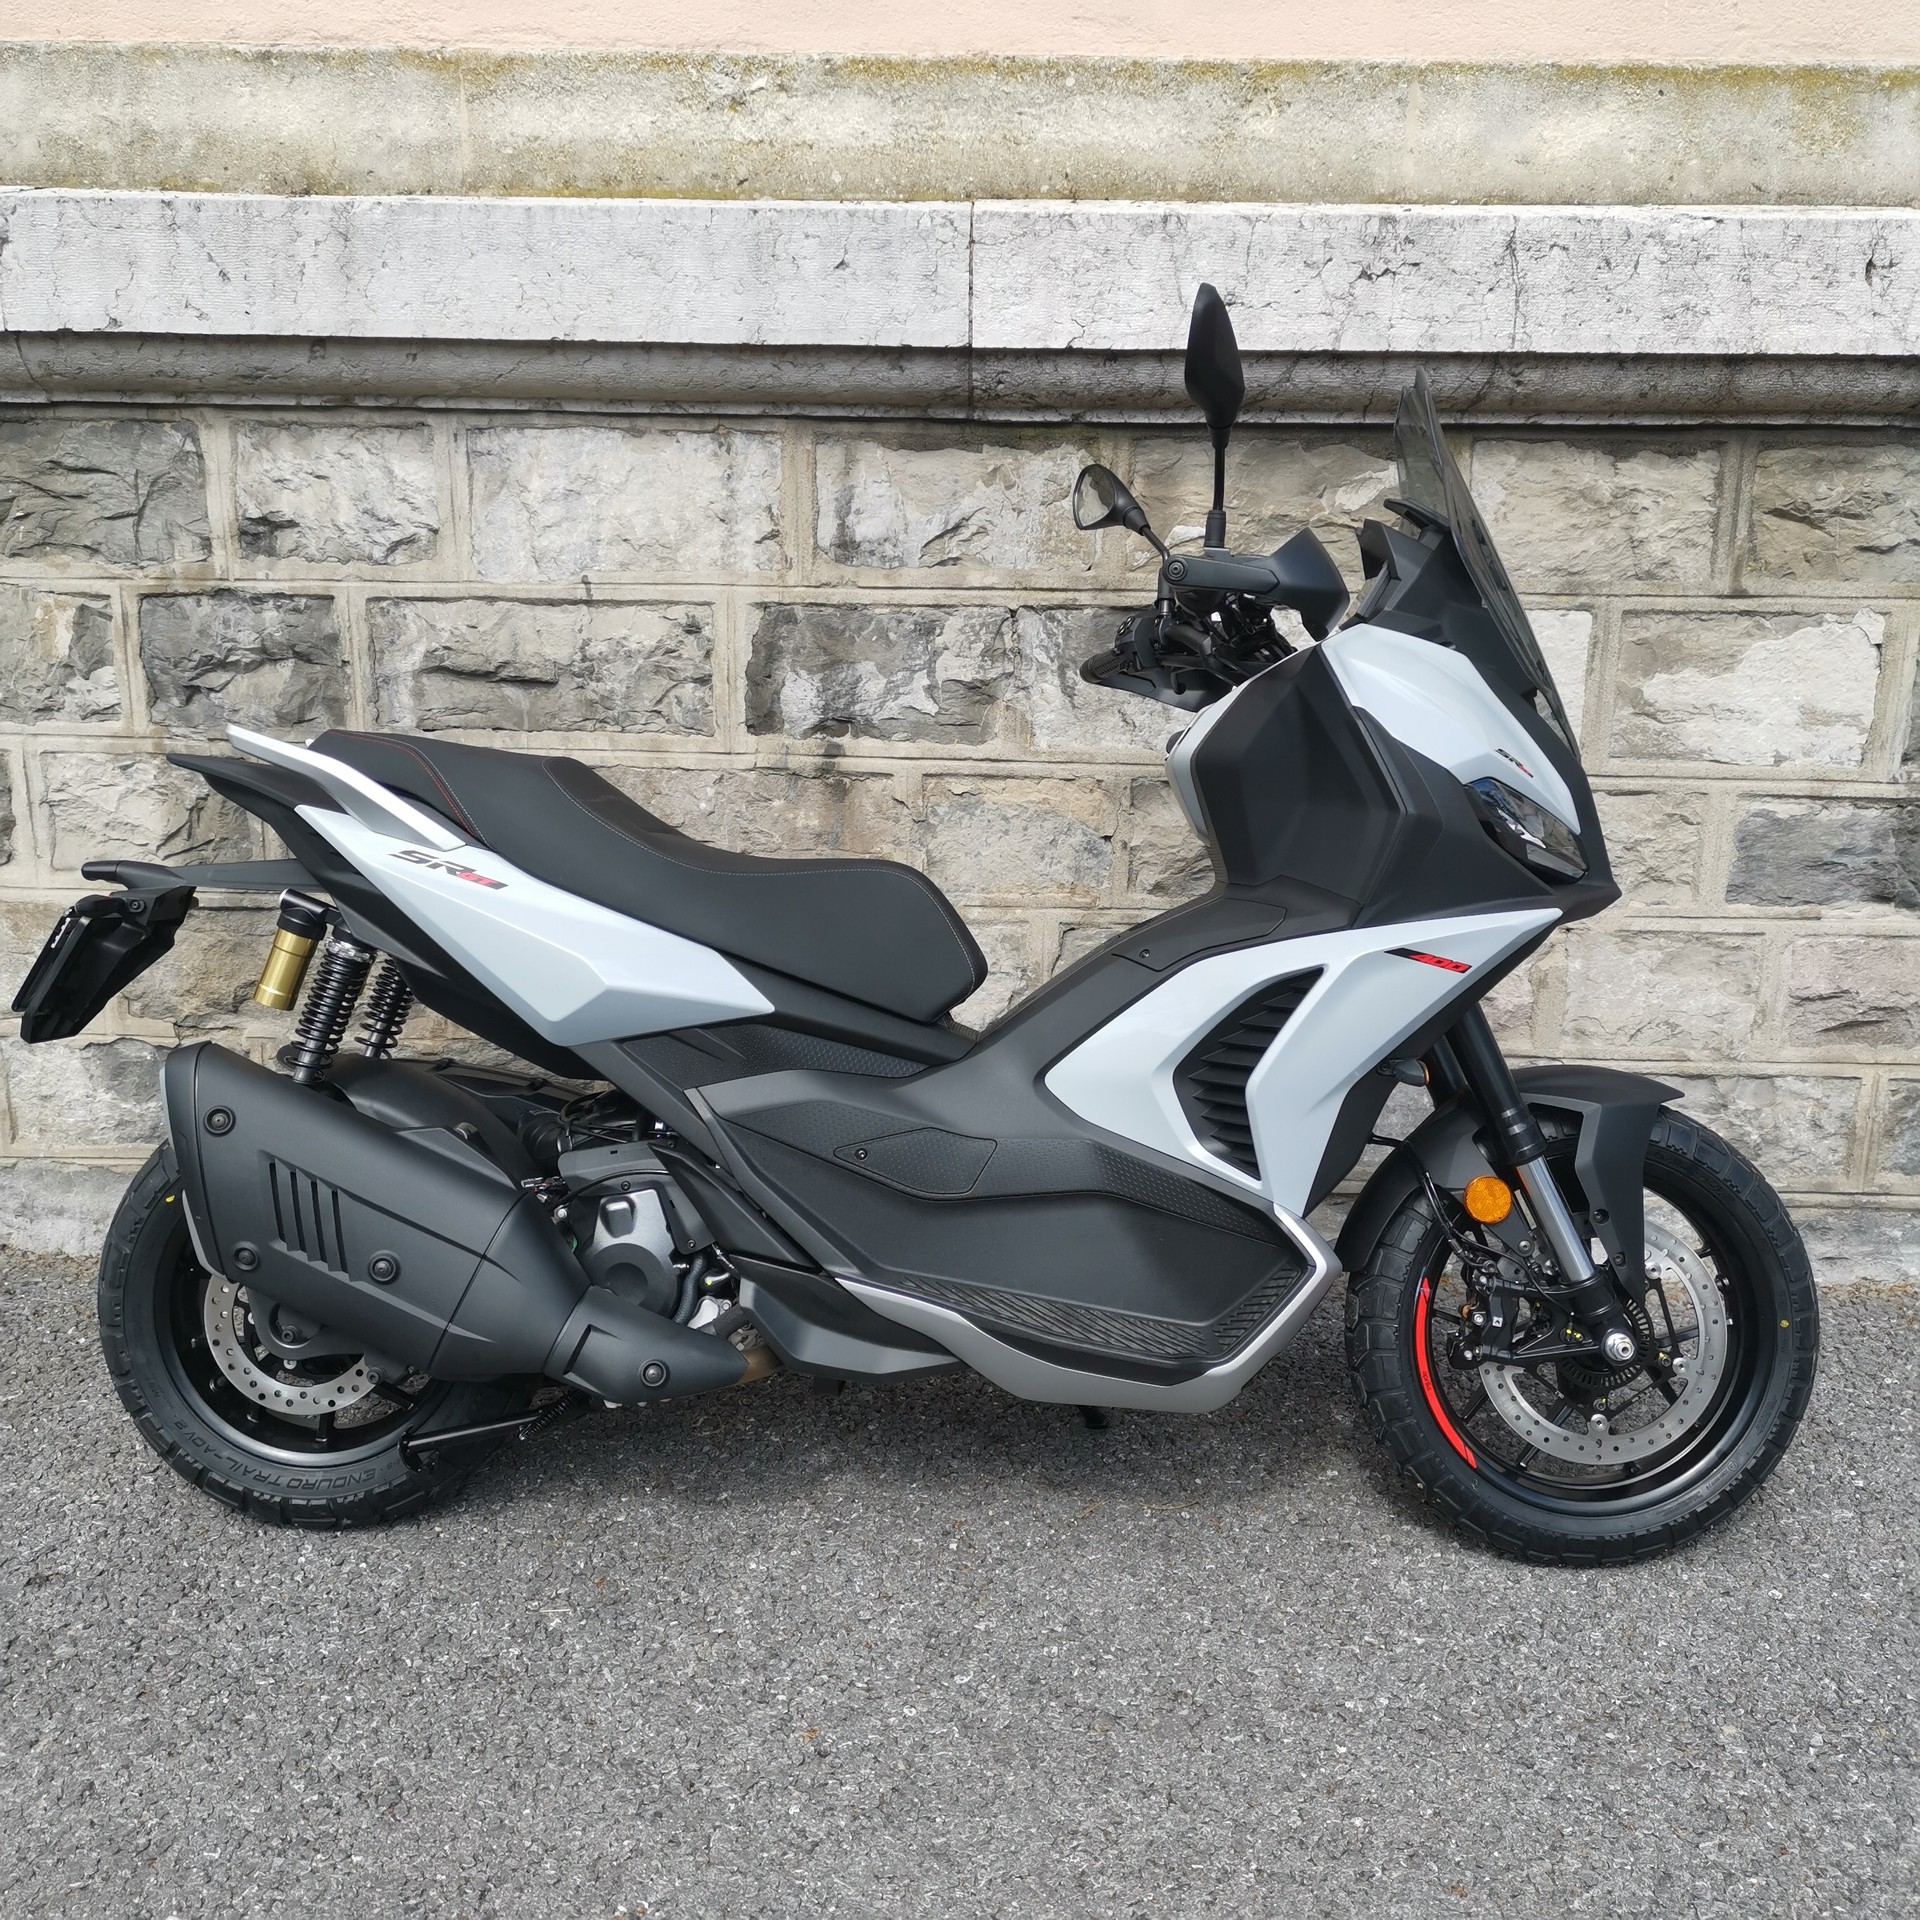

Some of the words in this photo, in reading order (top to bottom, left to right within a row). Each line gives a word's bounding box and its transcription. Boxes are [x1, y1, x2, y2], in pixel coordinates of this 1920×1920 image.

[386, 850, 478, 877] SR
[1409, 954, 1470, 973] 400
[286, 1468, 376, 1490] ENDURO
